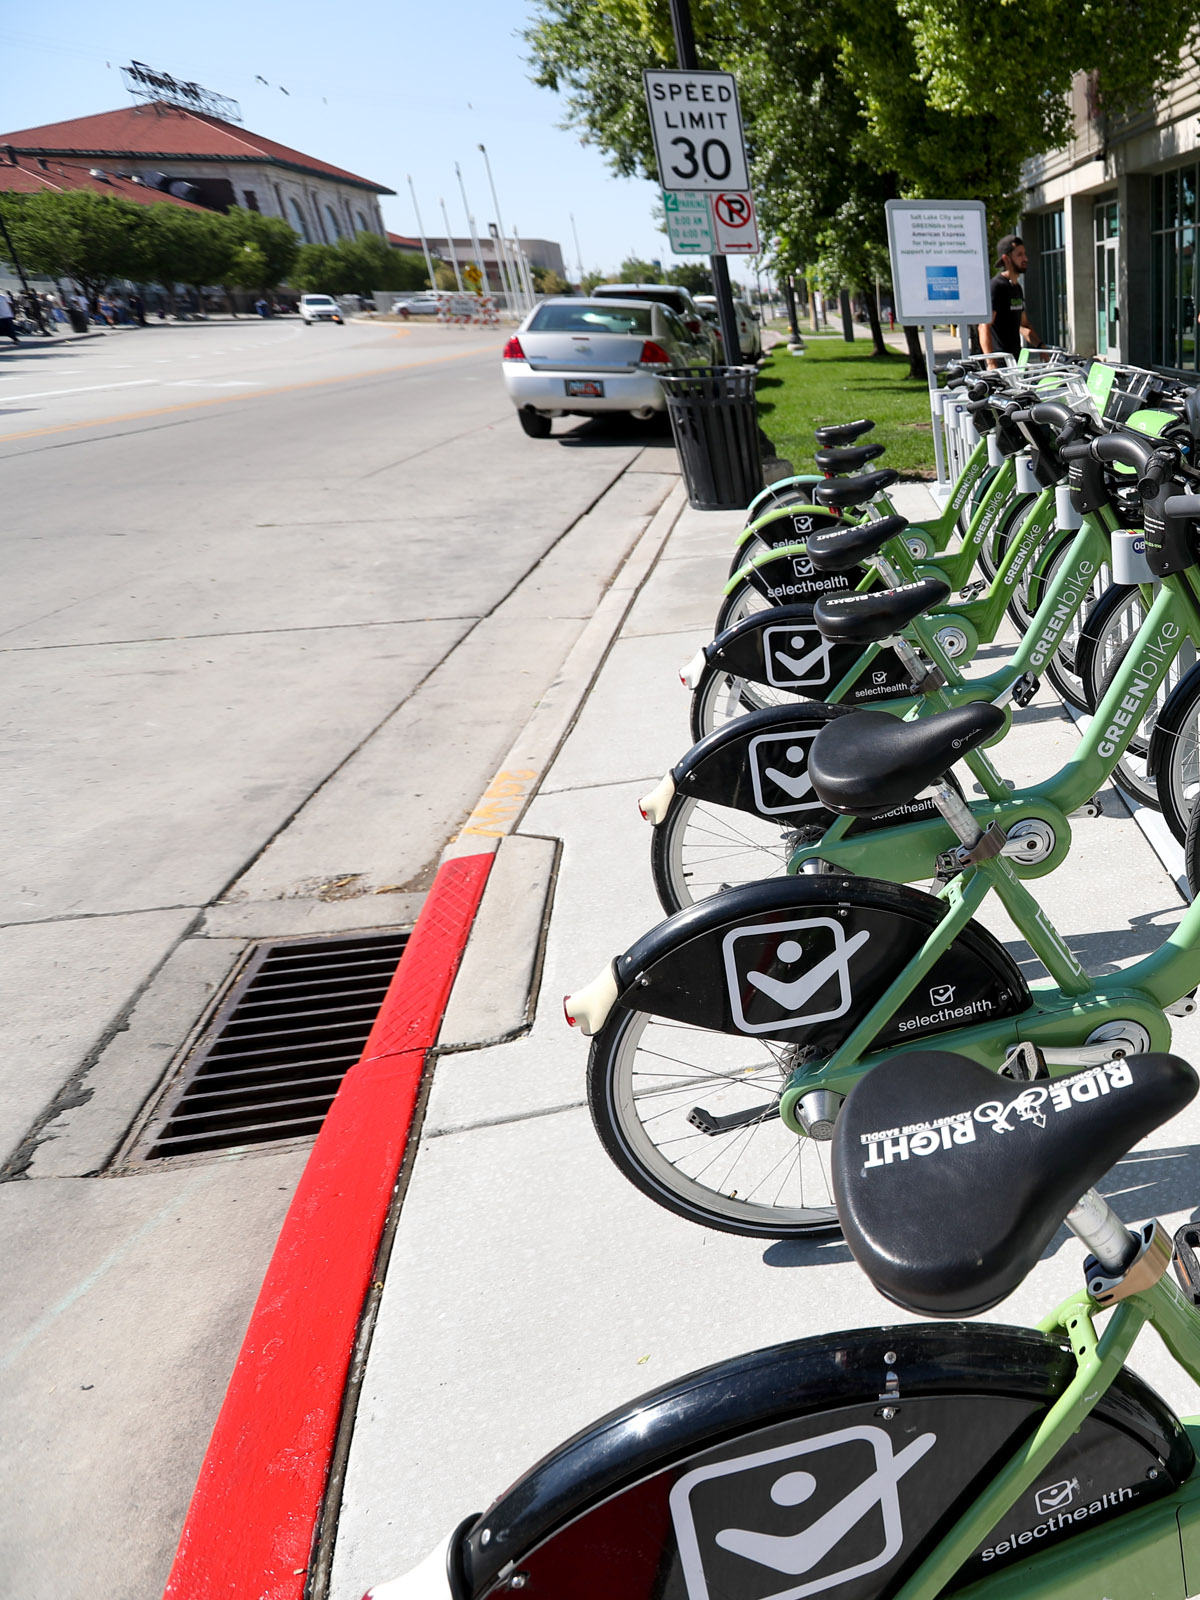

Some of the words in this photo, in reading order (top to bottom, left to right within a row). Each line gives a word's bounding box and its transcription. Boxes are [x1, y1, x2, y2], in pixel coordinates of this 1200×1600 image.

[653, 83, 731, 102] SPEED
[664, 111, 728, 130] LIMIT
[670, 136, 731, 180] 30
[952, 464, 979, 510] GREENbike
[972, 491, 1004, 544] GREENbike
[1004, 524, 1041, 585] GREENbike
[1134, 542, 1146, 550] 08
[767, 576, 849, 598] selecthealth
[1030, 560, 1094, 666] GREENbike
[855, 683, 908, 698] selecthealth
[1098, 621, 1180, 757] GREENbike
[898, 1000, 992, 1032] selecthealth
[1050, 1061, 1134, 1112] RIDE
[860, 1128, 900, 1143] SADDLE
[902, 1122, 930, 1134] YOUR
[933, 1110, 972, 1128] ADJUST
[864, 1119, 976, 1168] RIGHT
[982, 1488, 1133, 1562] selecthealth
